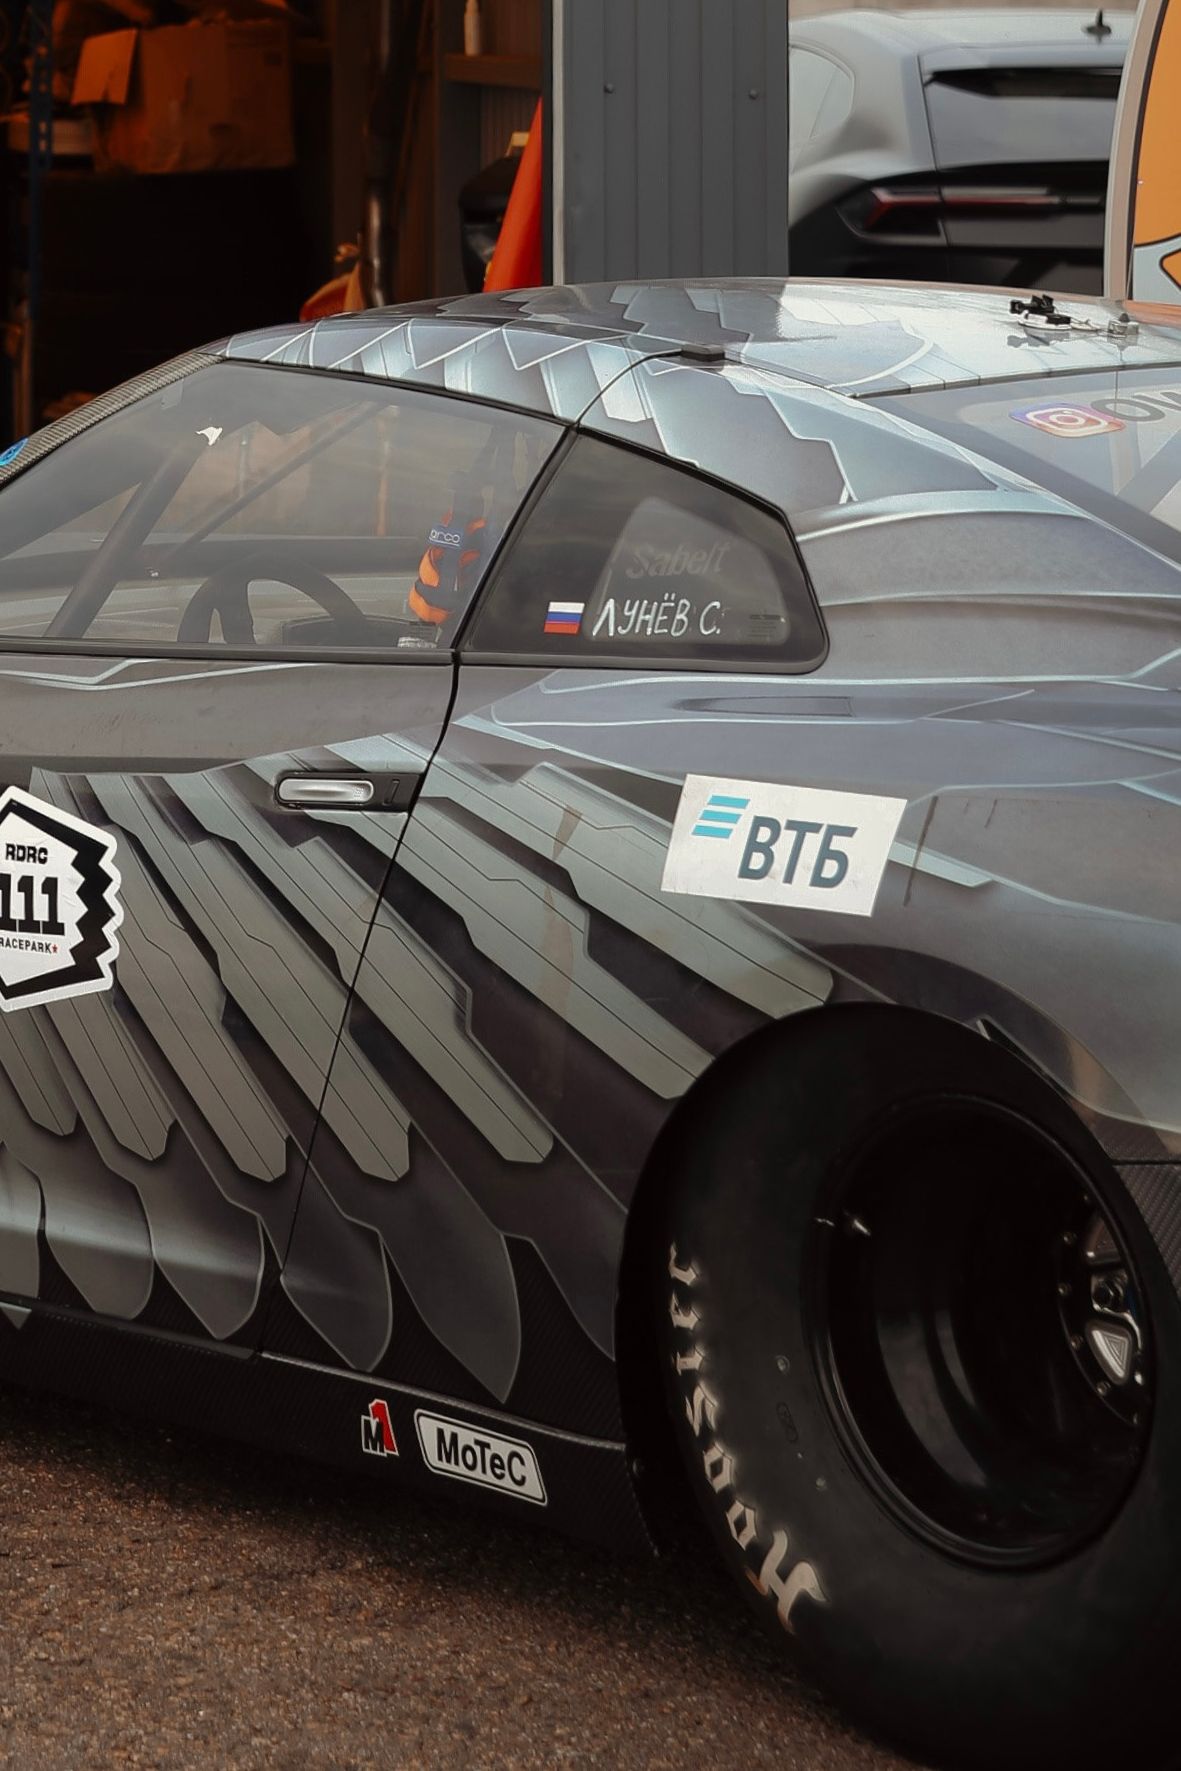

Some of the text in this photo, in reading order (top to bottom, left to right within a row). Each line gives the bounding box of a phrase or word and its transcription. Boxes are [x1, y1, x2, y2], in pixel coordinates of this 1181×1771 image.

[625, 540, 731, 579] Sabelt
[592, 592, 689, 637] ЛУНЁВ
[737, 814, 859, 889] ВТБ
[435, 1426, 527, 1487] MoTeC
[668, 1241, 828, 1636] Hoosier
